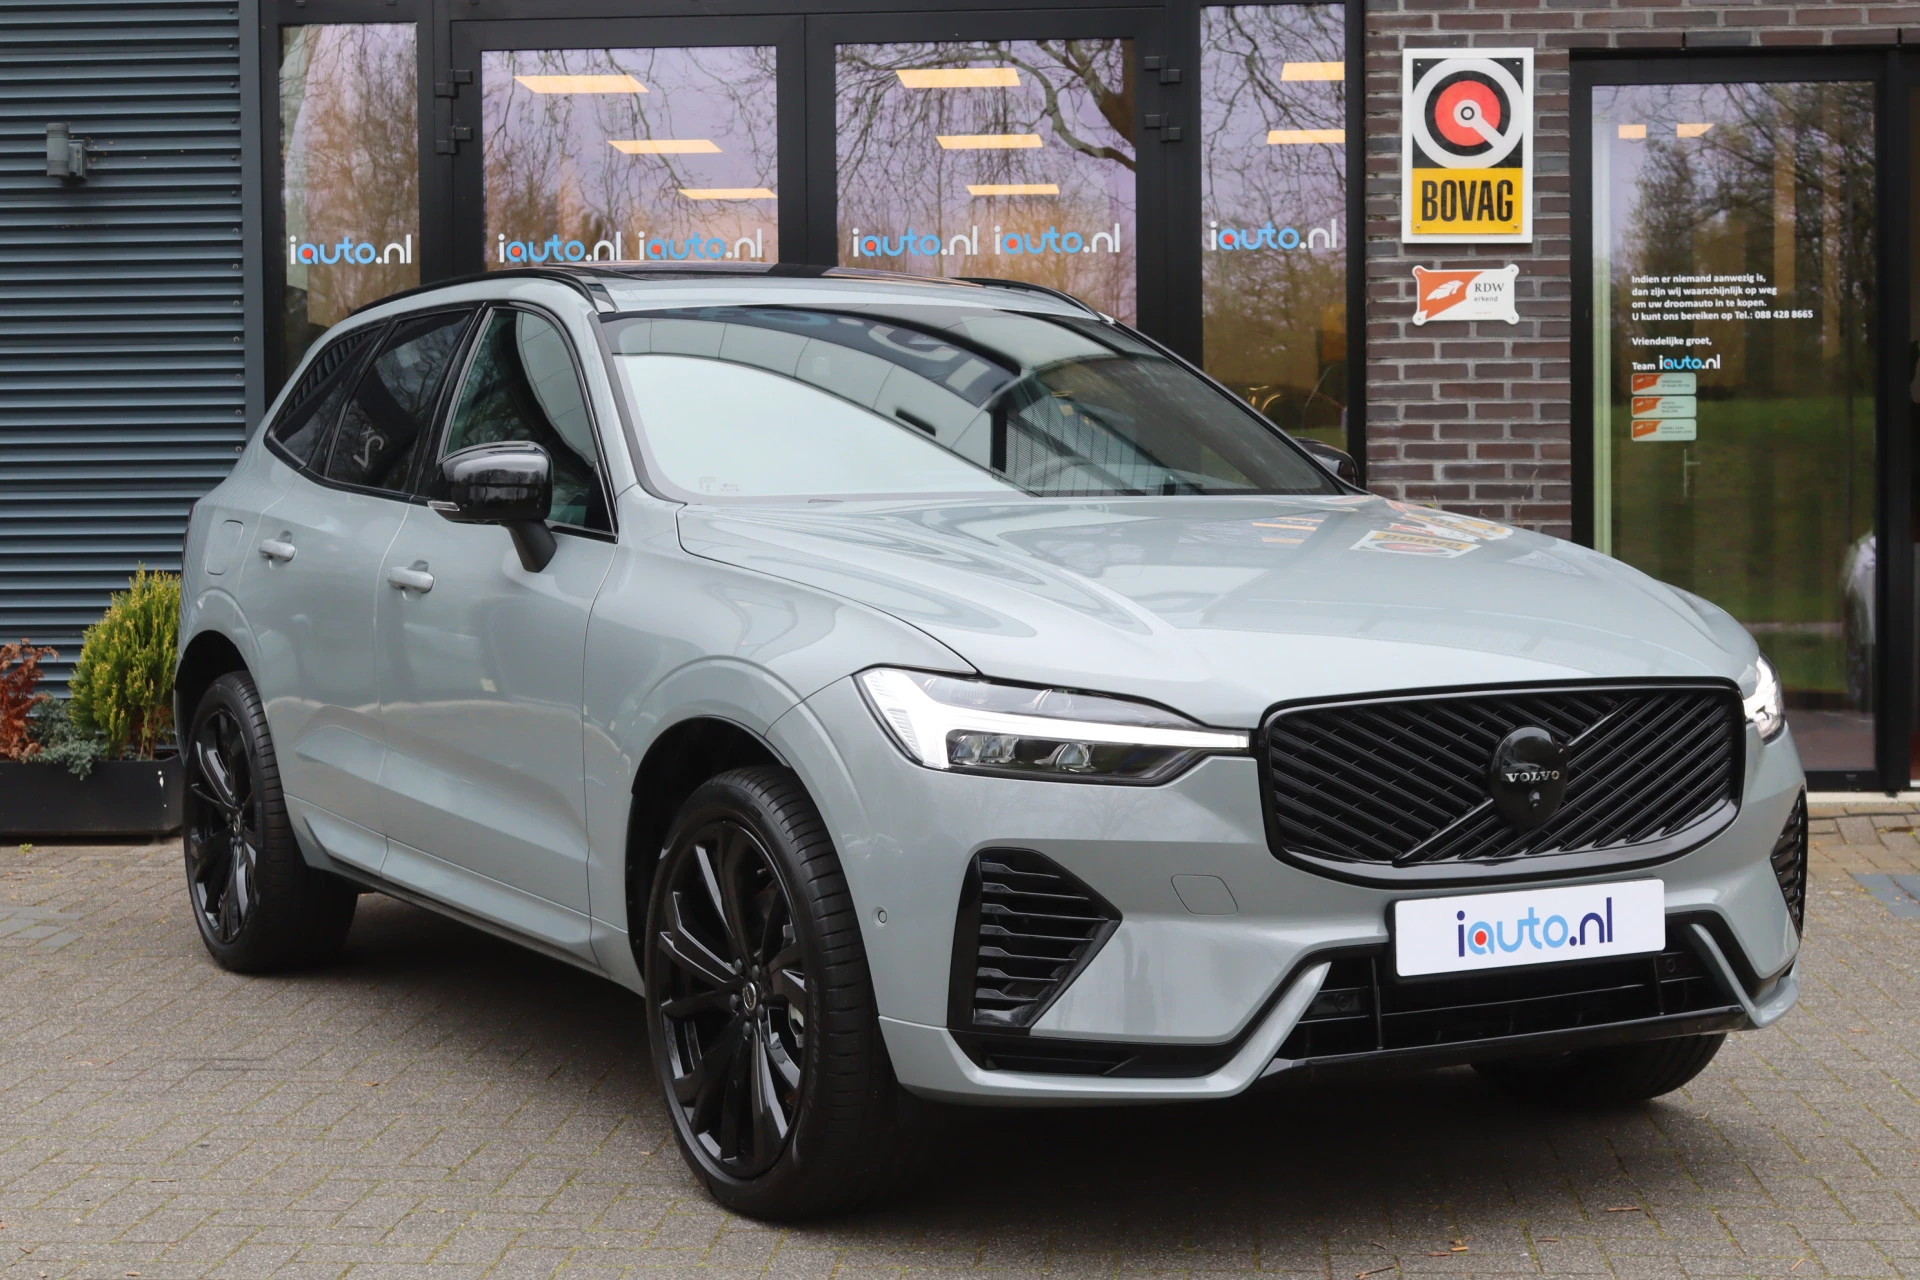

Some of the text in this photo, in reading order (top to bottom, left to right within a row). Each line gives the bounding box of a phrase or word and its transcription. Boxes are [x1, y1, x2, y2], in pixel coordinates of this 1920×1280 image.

[1421, 179, 1514, 222] BOVAG
[638, 228, 763, 261] iauto.nl
[852, 225, 978, 258] iauto.nl
[995, 223, 1121, 255] iauto.nl
[1210, 218, 1338, 252] iauto.nl
[290, 234, 412, 265] iauto.nl
[498, 231, 622, 264] iauto.nl
[1474, 283, 1504, 293] RDW
[1632, 274, 1659, 283] Indien
[1673, 274, 1711, 283] niemand
[1713, 273, 1754, 283] aanwezig
[1756, 273, 1766, 283] is,
[1632, 286, 1777, 297] dan zijn wij waarschijnlijk op weg
[1664, 299, 1713, 308] droomauto
[1715, 299, 1724, 307] in
[1726, 299, 1735, 307] te
[1737, 298, 1767, 308] kopen.
[1641, 312, 1661, 320] kunt
[1681, 311, 1719, 320] bereiken
[1721, 312, 1733, 321] op
[1754, 310, 1771, 319] 088
[1773, 310, 1789, 319] 428
[1791, 310, 1814, 318] 8665
[1632, 337, 1712, 347] Vriendelijke groet,
[1632, 354, 1720, 370] Team iauto.nl
[1505, 770, 1560, 783] VOLVO
[1456, 897, 1613, 957] iauto.nl
